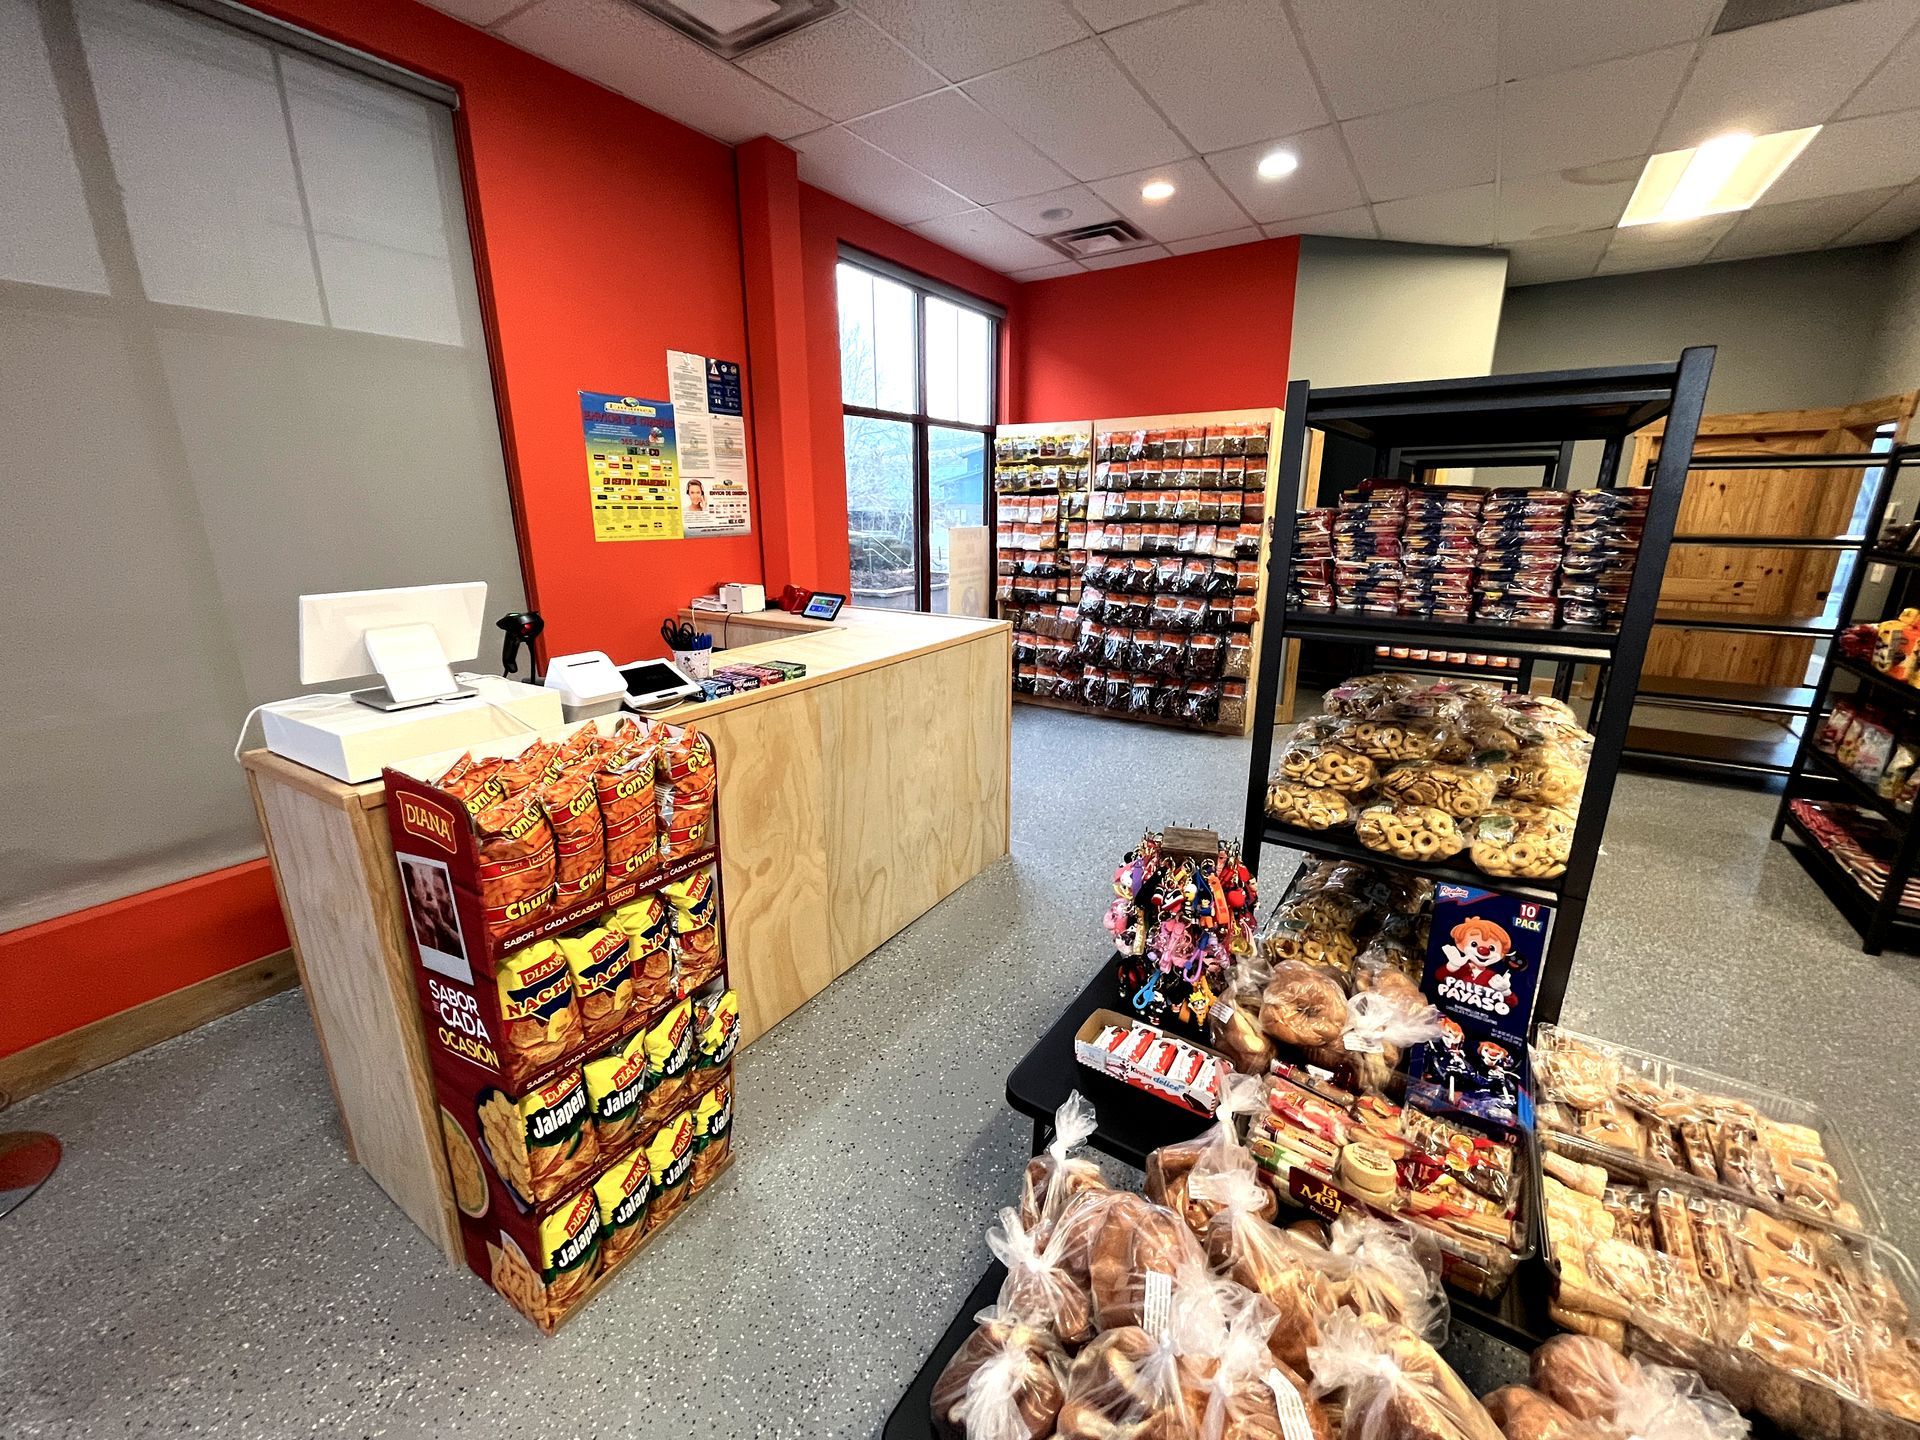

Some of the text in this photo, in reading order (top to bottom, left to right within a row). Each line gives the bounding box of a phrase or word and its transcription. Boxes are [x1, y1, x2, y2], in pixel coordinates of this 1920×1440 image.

[617, 776, 645, 799] Corn
[405, 803, 452, 842] DIANA
[610, 886, 633, 902] DIANA
[639, 875, 663, 890] SABOR
[669, 865, 688, 876] CADA
[503, 930, 534, 950] SABOR
[544, 916, 568, 931] CADA
[569, 900, 604, 920] OCASIÓN
[690, 899, 714, 928] NAC
[1515, 917, 1540, 931] PACK
[1521, 904, 1536, 918] 10
[578, 951, 631, 996] NACH
[1445, 976, 1504, 1003] PALETA
[429, 979, 480, 1017] SABOR
[651, 998, 673, 1016] SABOR
[1437, 983, 1510, 1016] PAYASO
[440, 1002, 491, 1044] CADA
[438, 1026, 500, 1069] OCASIÓN
[526, 1069, 555, 1090] SABOR
[564, 1052, 585, 1068] CADA
[1153, 1077, 1180, 1092] delice
[533, 1086, 586, 1139] Jalapeñ
[602, 1083, 641, 1117] Jalap
[1504, 1132, 1517, 1143] 10
[567, 1194, 593, 1235] DIANA
